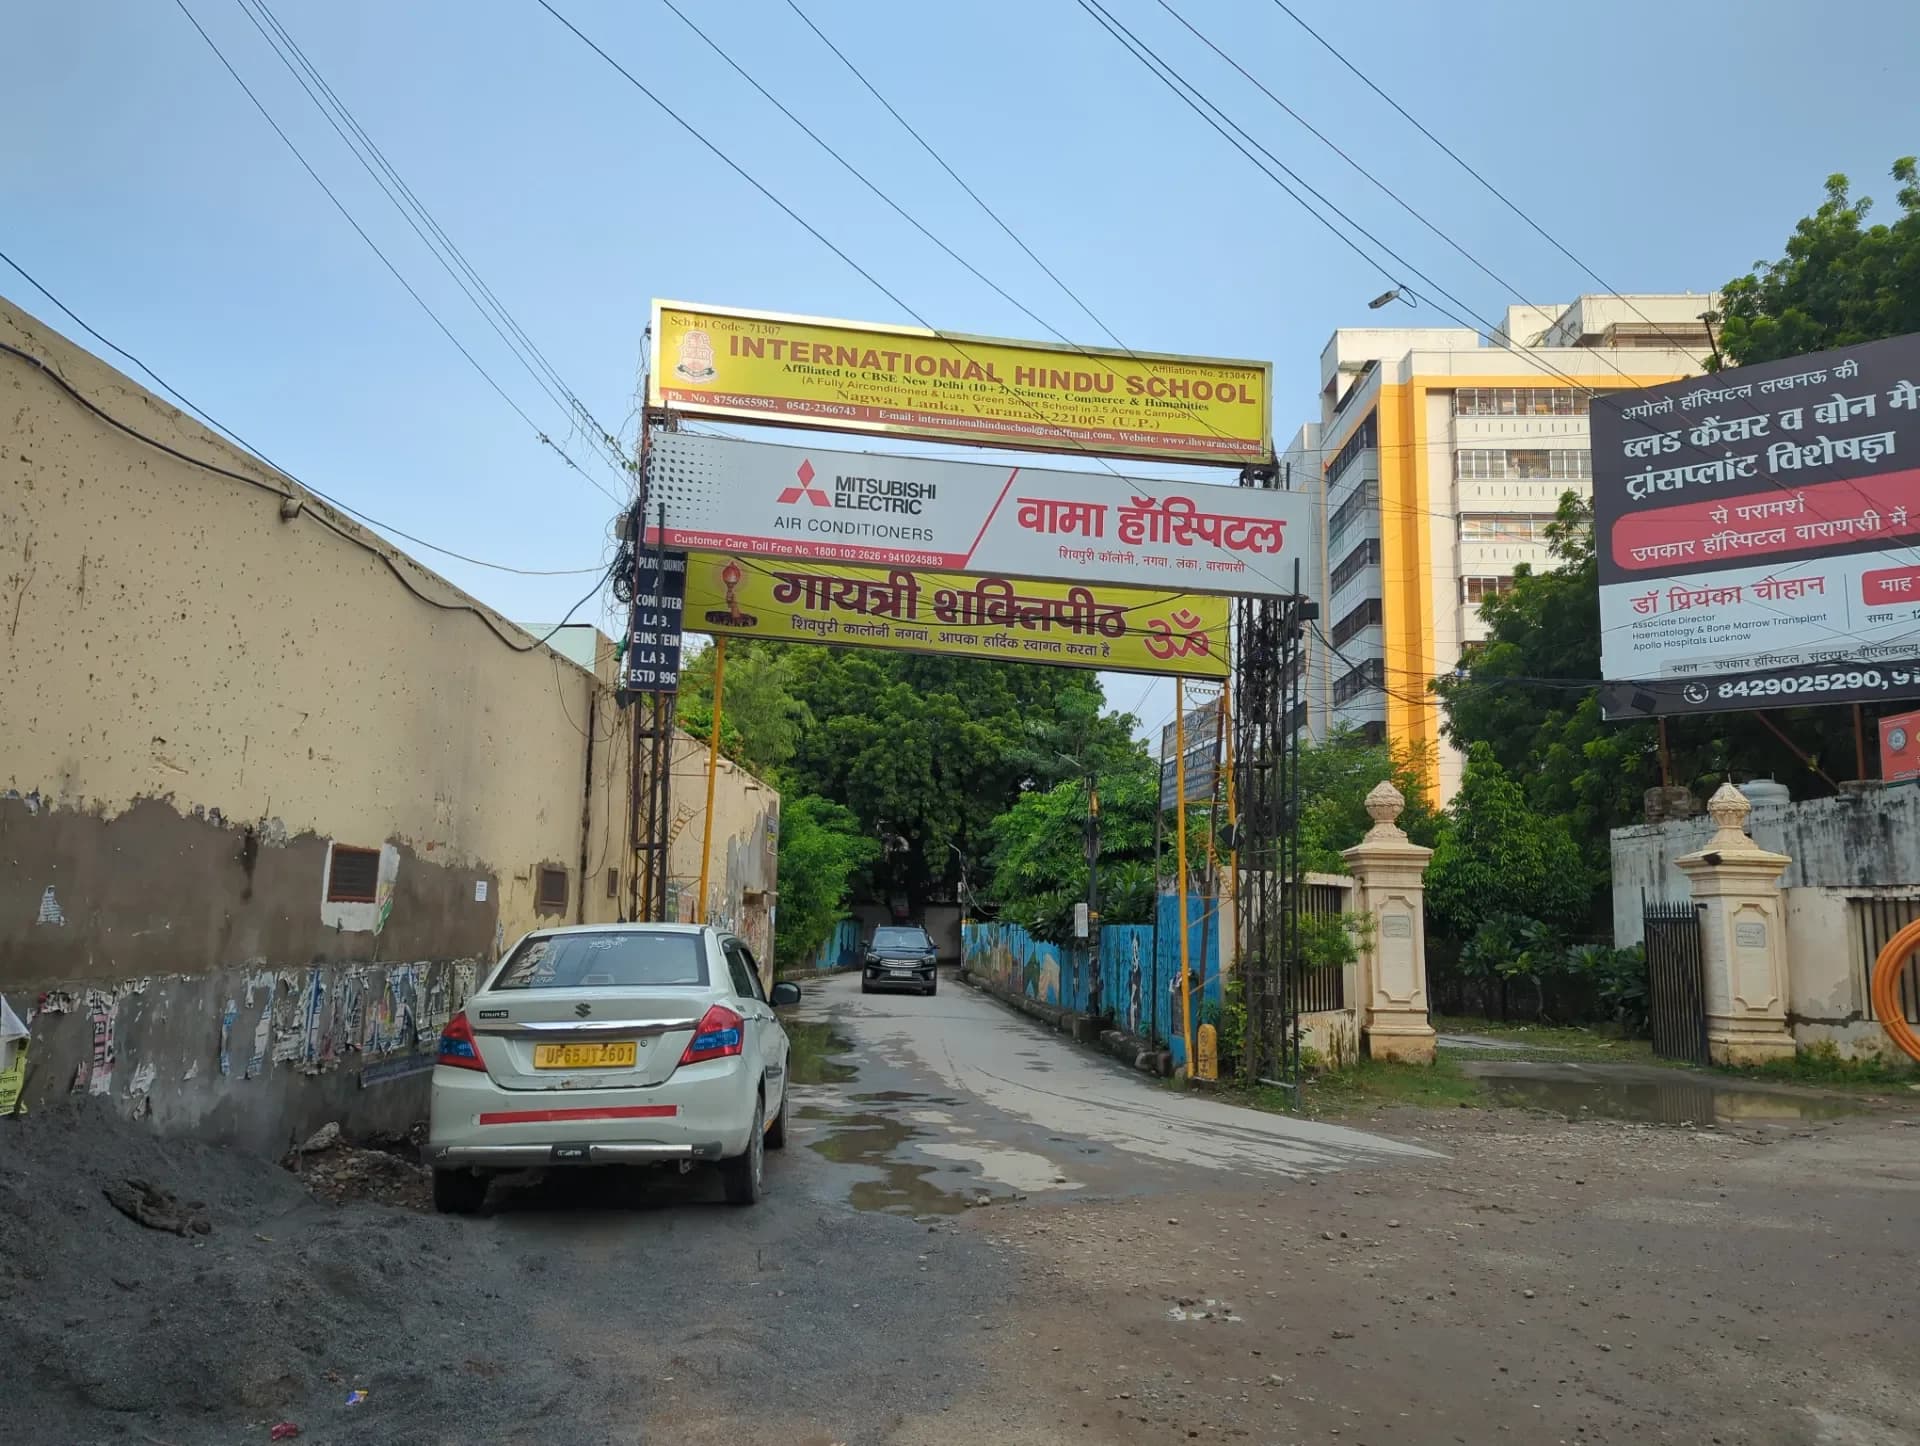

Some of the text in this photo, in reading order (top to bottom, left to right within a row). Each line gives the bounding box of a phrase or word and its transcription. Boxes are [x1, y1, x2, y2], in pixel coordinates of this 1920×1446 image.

[671, 316, 708, 329] School
[749, 324, 781, 336] 71307
[730, 335, 1256, 405] INTERNATIONAL HINDU SCHOOL
[1151, 365, 1197, 376] Affiliation
[1199, 369, 1216, 378] No.
[782, 363, 840, 377] Affiliated
[845, 370, 857, 379] to
[862, 371, 898, 383] CBSE
[903, 375, 929, 386] New
[933, 379, 964, 391] Delhi
[1014, 387, 1060, 401] Science,
[1065, 393, 1125, 405] Commerce
[1129, 399, 1140, 407] &
[1145, 398, 1209, 411] Humanities
[817, 377, 844, 388] Fully
[847, 381, 928, 396] Airconditioned
[931, 389, 939, 397] &
[942, 391, 969, 400] Lush
[972, 393, 1004, 404] Green
[1008, 398, 1039, 408] Smart
[1041, 401, 1079, 413] School
[1110, 408, 1141, 417] Acres
[836, 389, 899, 406] Nagwa,
[906, 397, 965, 413] Lanka,
[1620, 358, 1859, 421] अपोलो हॉस्पिटल लखनऊ की
[668, 391, 686, 400] Ph.
[880, 410, 915, 422] E-mail:
[1622, 428, 1683, 459] ब्लड
[1689, 412, 1772, 449] कैंसर
[1779, 405, 1804, 431] व
[1813, 391, 1877, 425] बोन
[1623, 429, 1897, 500] ट्रांसप्लांट विशेषज्ञ
[835, 475, 937, 500] MITSUBISHI
[834, 492, 923, 515] ELECTRIC
[1708, 490, 1806, 526] से परामर्श
[773, 515, 935, 542] AIR CONDITIONERS
[1016, 495, 1288, 554] वामा हॉस्पिटल
[1630, 504, 1909, 563] उपकार हॉस्पिटल वाराणसी में
[673, 533, 944, 566] Customer Care Toll Free No. 1800 102 2626 9410245883
[1058, 545, 1096, 566] शिवपुरी
[1205, 559, 1246, 574] वाराणसी
[772, 567, 922, 621] गायत्री
[1629, 574, 1826, 615] डॉ प्रियंका चौहान
[1877, 576, 1914, 592] माह
[635, 593, 683, 611] COMUTER
[1632, 614, 1716, 630] Associate Director
[1632, 612, 1828, 640] Haematology & Bone Marrow Transplant
[1865, 611, 1894, 624] समय
[791, 614, 839, 637] शिवपुरी
[842, 620, 890, 638] कालोनी
[937, 631, 979, 647] आपका
[982, 631, 1019, 650] हार्दिक
[1022, 639, 1062, 655] स्वागत
[1065, 642, 1099, 657] करता
[1100, 641, 1111, 658] है
[1633, 632, 1752, 652] Apollo Hospitals Lucknow
[1671, 662, 1698, 673] स्थान
[1717, 669, 1889, 699] 8429025290,
